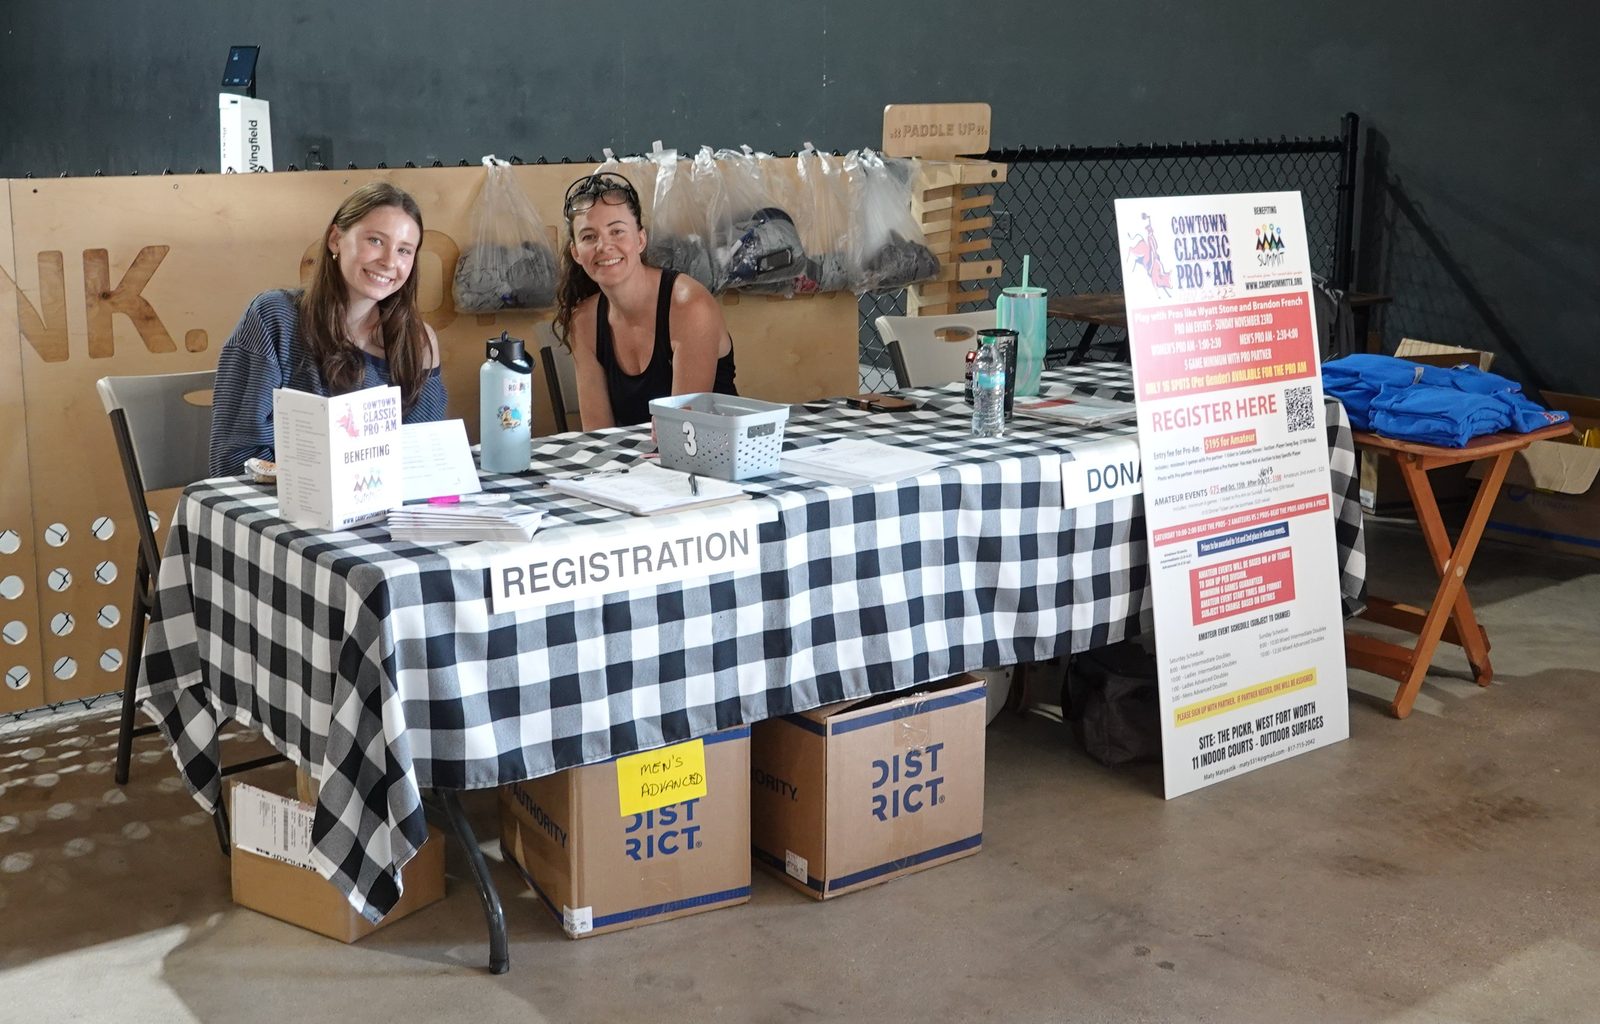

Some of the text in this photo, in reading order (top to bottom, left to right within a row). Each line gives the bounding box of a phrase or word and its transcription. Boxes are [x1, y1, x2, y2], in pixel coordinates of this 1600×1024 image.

[903, 122, 975, 138] PADDLE UP
[248, 119, 260, 173] Wingfield
[1254, 206, 1277, 215] BENEFITING
[1171, 214, 1227, 235] COWTOWN
[1174, 235, 1231, 262] CLASSIC
[1257, 252, 1285, 268] SUMMIT
[1176, 260, 1234, 289] PRO AM
[1168, 308, 1183, 319] Pros
[1184, 307, 1197, 318] like
[1198, 305, 1218, 318] Wyatt
[1219, 303, 1238, 314] Stone
[1238, 302, 1252, 312] and
[1253, 299, 1280, 310] Brandon
[1281, 296, 1303, 307] French
[1174, 313, 1274, 335] PRO AM EVENTS SUNDAY NOVEMBER 23RD
[1151, 342, 1176, 357] WOMEN'S
[1175, 341, 1187, 354] PRO
[1186, 340, 1195, 352] AM
[1239, 333, 1255, 346] MEN'S
[1254, 331, 1265, 344] PRO
[1264, 330, 1273, 343] AM
[1188, 357, 1203, 370] GAME
[1203, 354, 1227, 368] MINIMUM
[1227, 352, 1240, 365] WITH
[1240, 351, 1251, 363] PRO
[1251, 348, 1272, 362] PARTNER
[1145, 380, 1161, 395] ONLY
[1170, 377, 1191, 391] SPOTS
[1231, 367, 1261, 383] AVAILABLE
[1261, 365, 1273, 378] FOR
[1274, 364, 1284, 377] THE
[1285, 362, 1297, 375] PRO
[1297, 361, 1307, 374] AM
[363, 397, 396, 411] COWTOWN
[363, 407, 397, 423] CLASSIC
[1152, 394, 1278, 432] REGISTER HERE
[363, 419, 397, 437] PRO AM
[682, 421, 698, 456] 3
[1205, 431, 1255, 450] $195 for Amateur
[344, 444, 390, 464] BENEFITING
[1153, 451, 1167, 461] Entry
[1087, 461, 1142, 493] DON
[1154, 489, 1208, 506] AMATEUR EVENTS
[502, 528, 749, 598] REGISTRATION
[1198, 610, 1290, 641] AMATEUR EVENT SCHEDULE (SUBJECT TO CHANGE)
[1199, 701, 1316, 750] SITE: THE PICKR, WEST FORT WORTH
[1192, 715, 1324, 770] 11 INDOOR COURTS OUTDOOR SURFACES
[640, 755, 684, 776] MEN'S
[872, 743, 944, 789] DIST
[641, 772, 703, 798] ADVANCED
[513, 783, 567, 849] AUTHORITY
